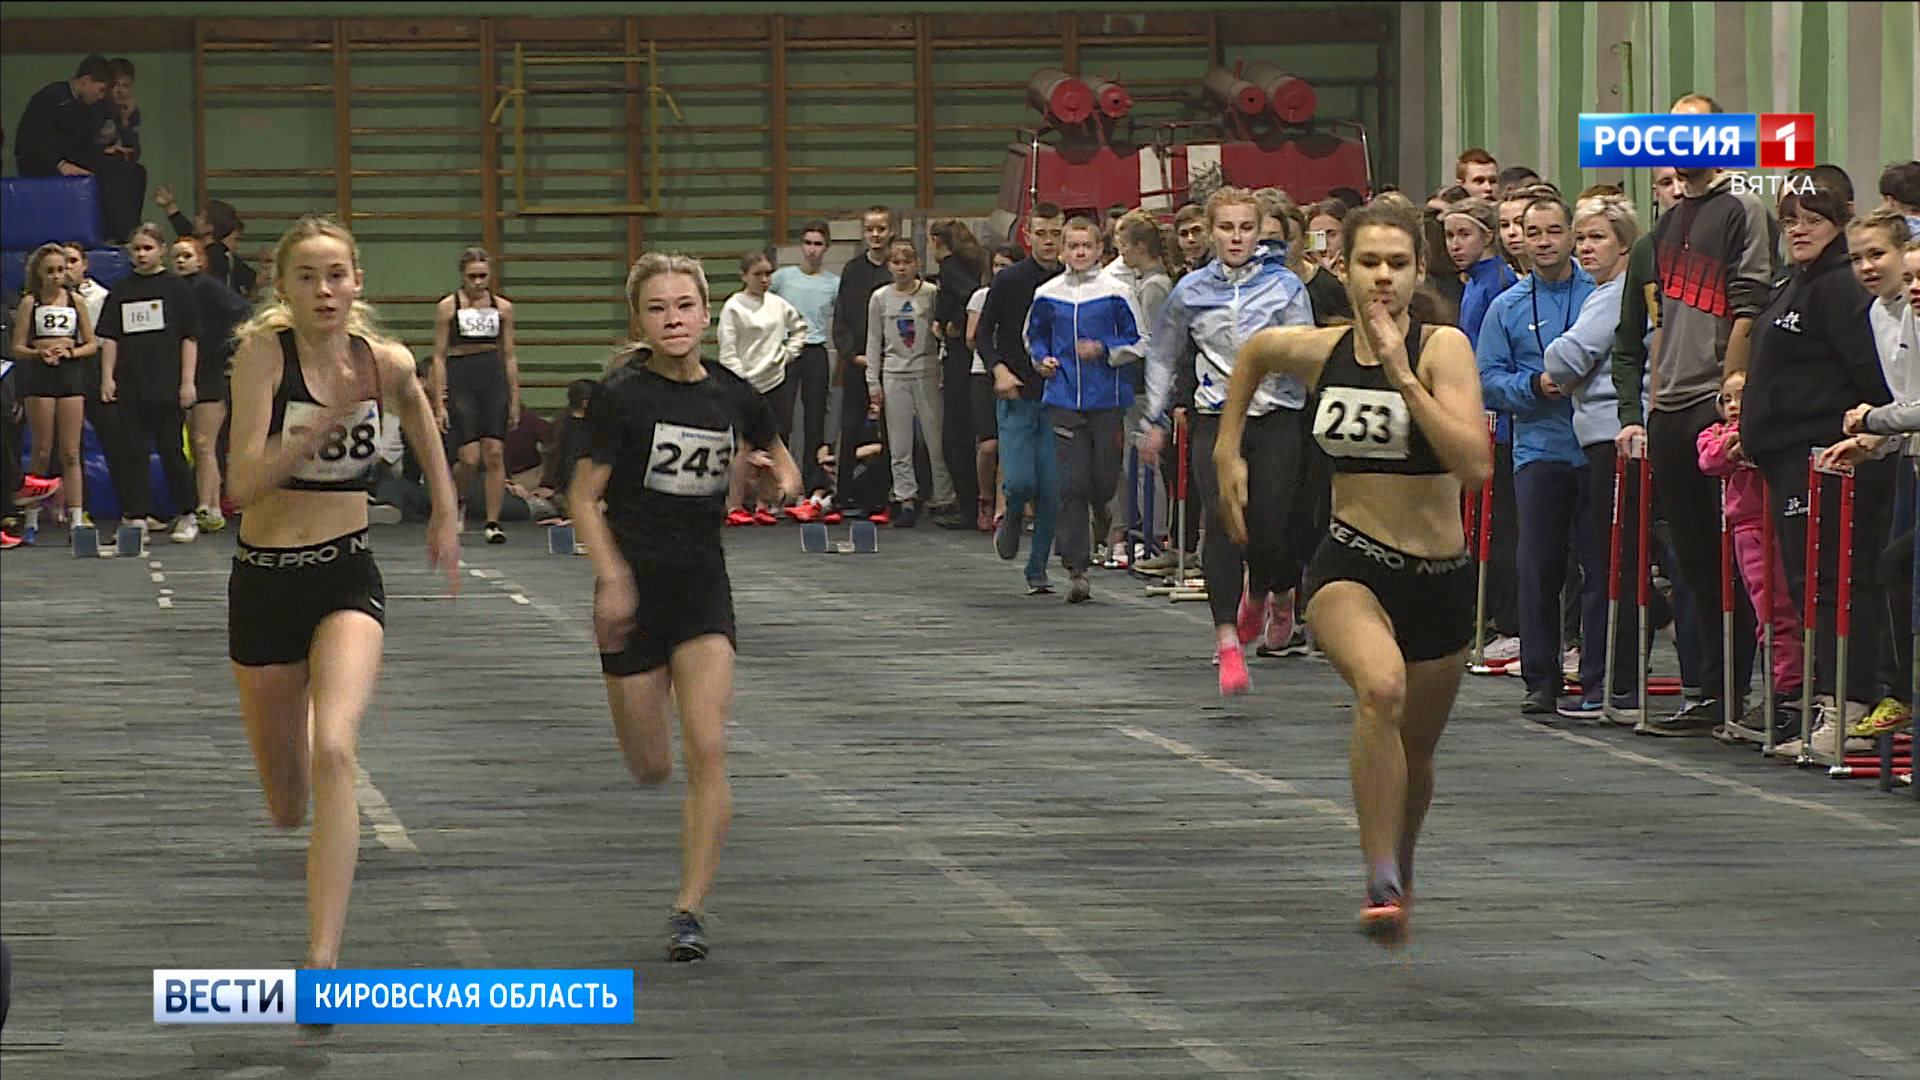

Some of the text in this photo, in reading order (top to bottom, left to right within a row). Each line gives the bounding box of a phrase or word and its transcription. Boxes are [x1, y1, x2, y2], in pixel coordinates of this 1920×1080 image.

[43, 313, 70, 329] 82
[465, 317, 495, 331] 584
[1325, 401, 1392, 444] 253
[651, 442, 732, 478] 243
[278, 544, 340, 569] PRO
[1348, 534, 1406, 571] PRO
